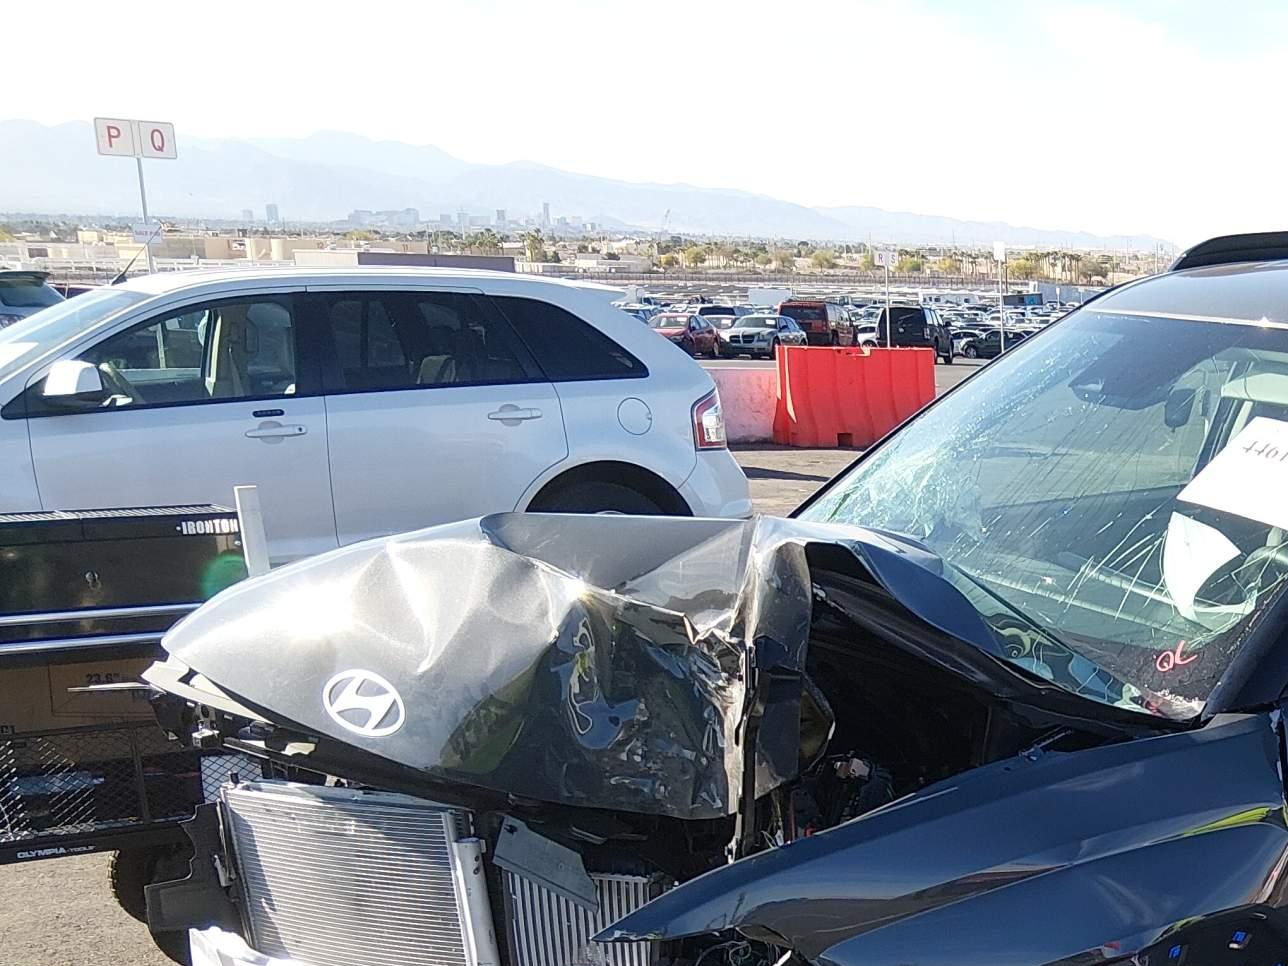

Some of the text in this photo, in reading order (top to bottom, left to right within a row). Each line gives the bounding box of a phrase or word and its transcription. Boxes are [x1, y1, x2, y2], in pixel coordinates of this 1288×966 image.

[106, 125, 165, 152] P Q
[181, 518, 239, 535] IRONTON
[17, 847, 66, 859] OLYMPIA
